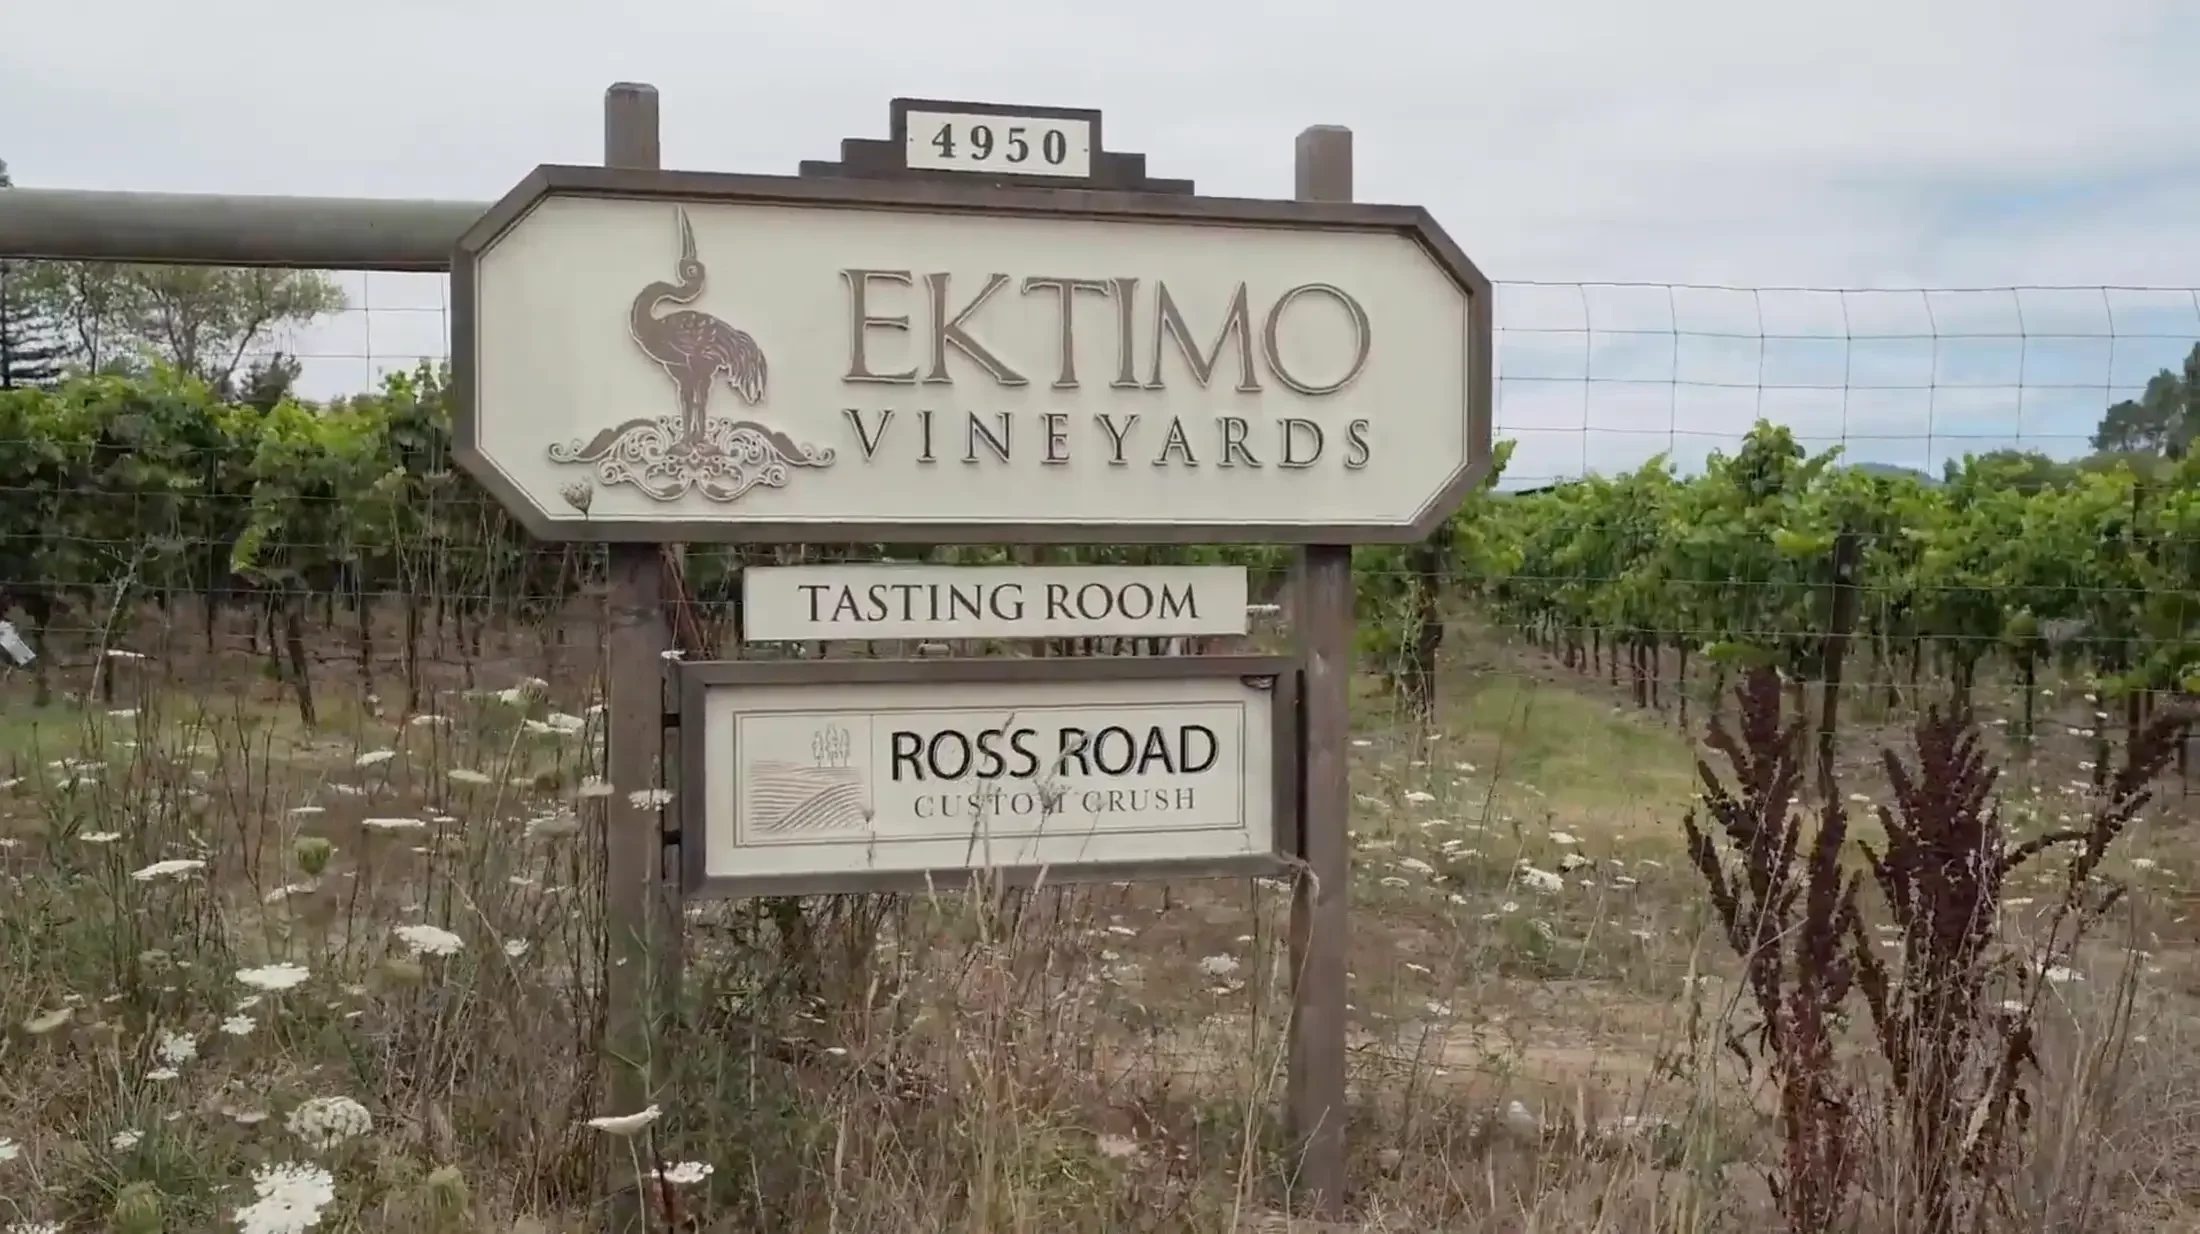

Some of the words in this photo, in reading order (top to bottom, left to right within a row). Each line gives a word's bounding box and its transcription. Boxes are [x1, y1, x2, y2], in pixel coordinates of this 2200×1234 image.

[931, 121, 1068, 165] 4950
[840, 268, 1371, 395] EKTIMO
[843, 408, 1371, 469] VINEYARDS
[798, 583, 1025, 622] TASTING
[1045, 581, 1200, 621] ROOM
[891, 728, 1040, 782] ROSS
[1059, 724, 1219, 777] ROAD
[1082, 787, 1196, 815] CRUSH
